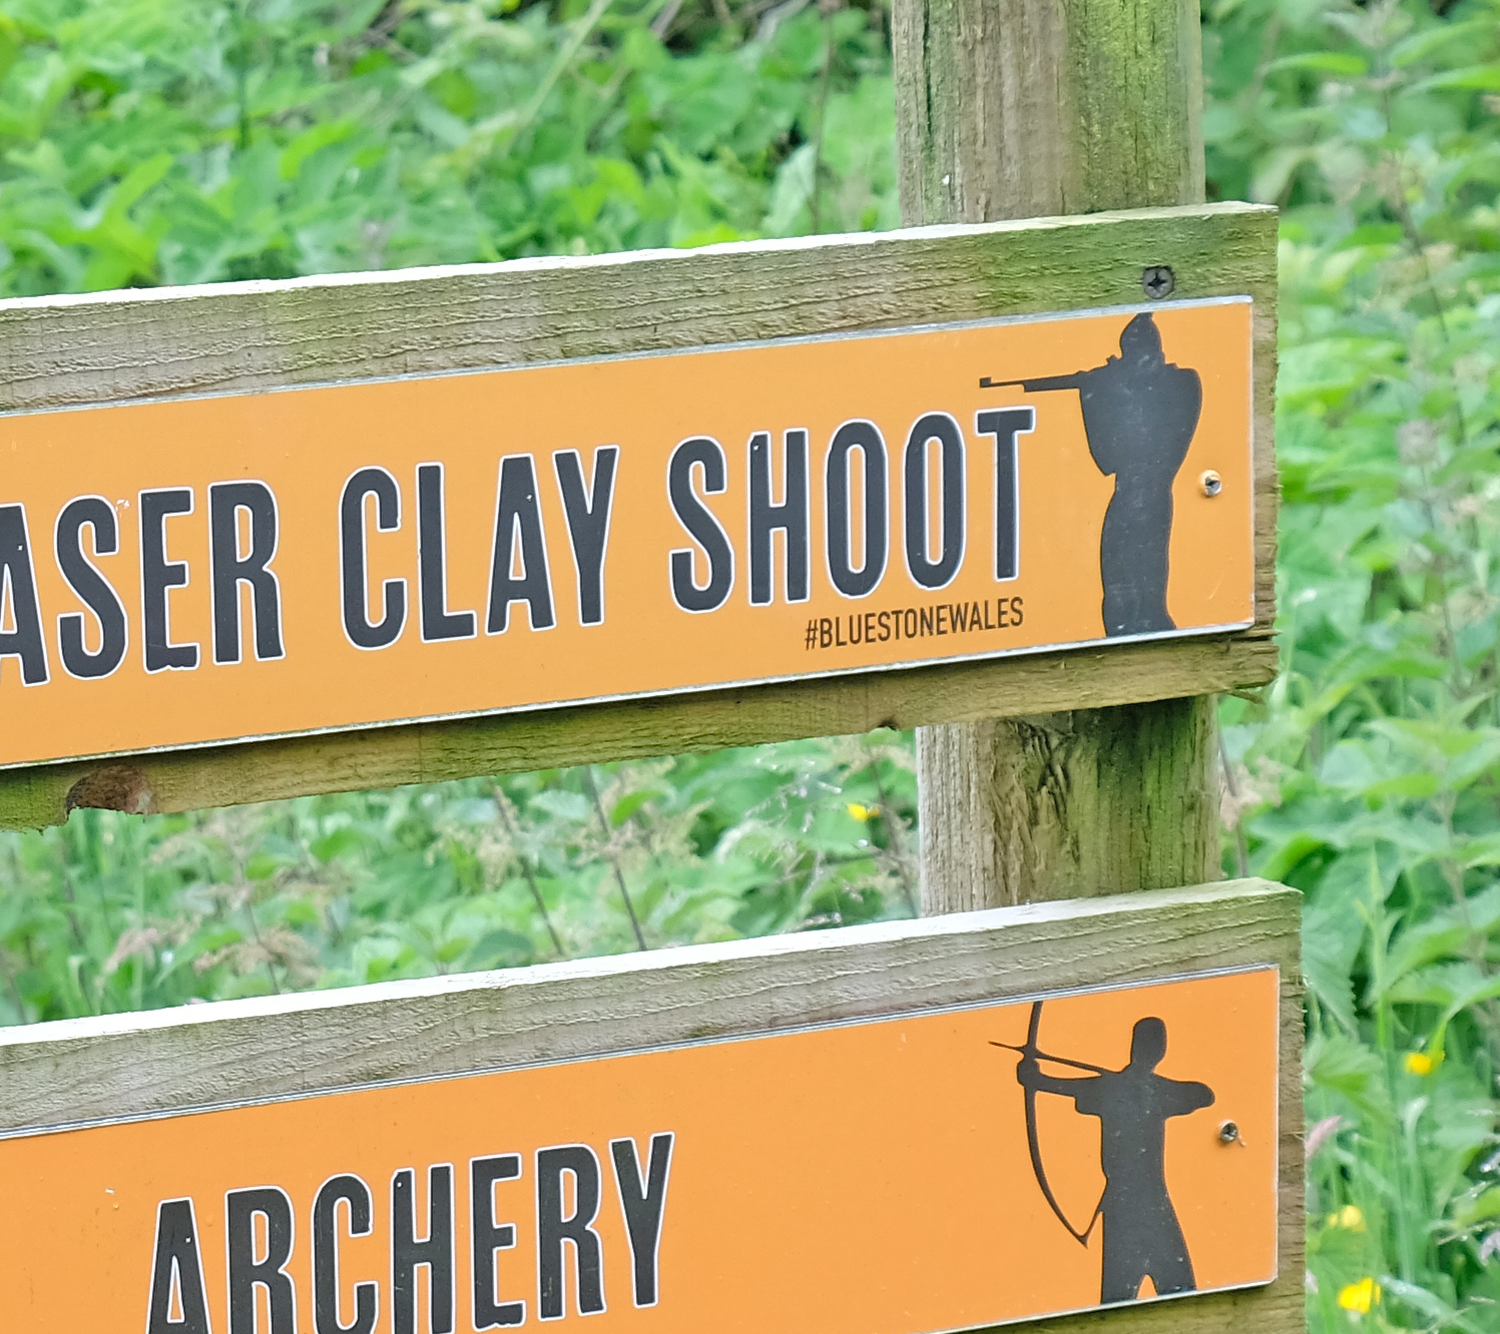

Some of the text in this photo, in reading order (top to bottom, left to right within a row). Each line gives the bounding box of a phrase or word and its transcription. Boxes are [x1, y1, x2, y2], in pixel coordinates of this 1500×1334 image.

[337, 445, 620, 652] CLAY
[666, 405, 1037, 616] SHOOT
[803, 595, 1025, 652] #BLUESTONEWALES
